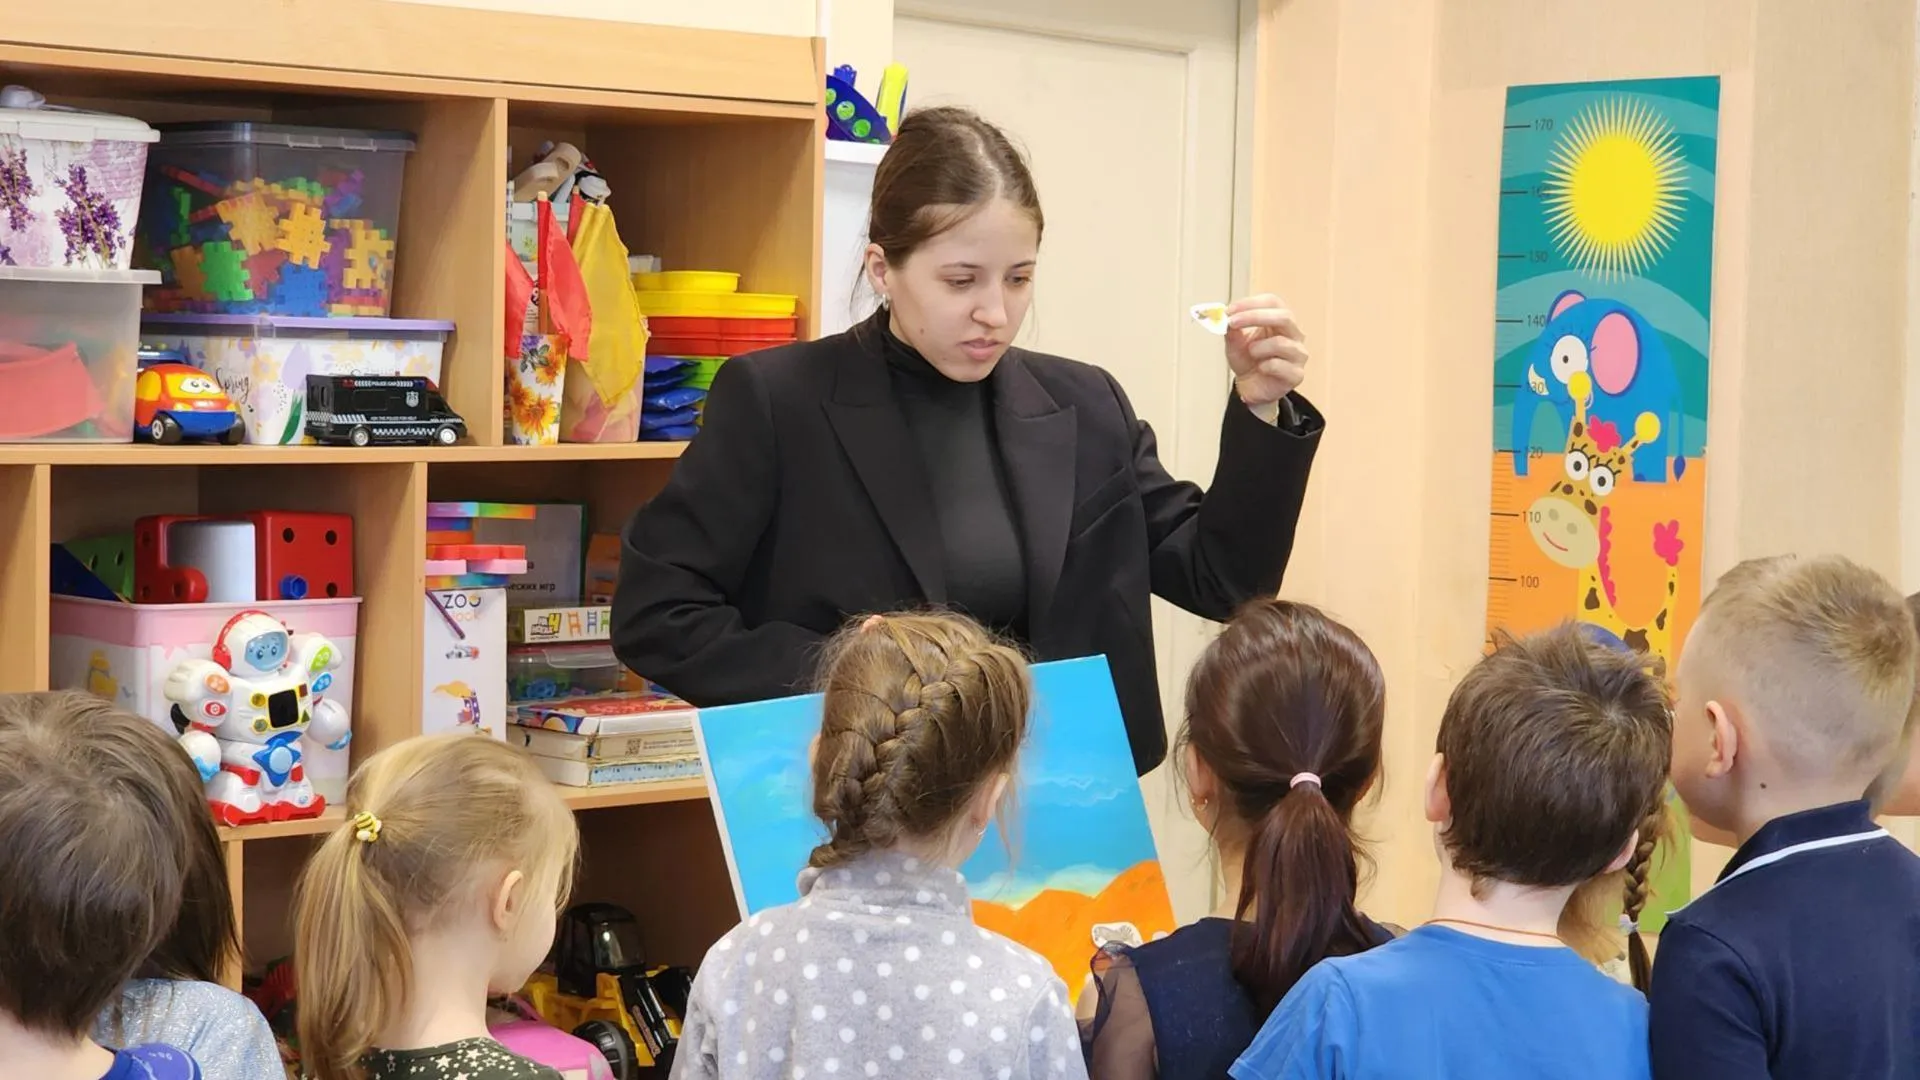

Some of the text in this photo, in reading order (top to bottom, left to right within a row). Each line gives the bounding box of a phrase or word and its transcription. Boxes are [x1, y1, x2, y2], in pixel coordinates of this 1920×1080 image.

[1535, 119, 1554, 131] 170
[1530, 251, 1549, 263] 150
[1528, 314, 1546, 328] 140
[215, 367, 250, 404] Spring
[1527, 381, 1545, 393] 130
[1522, 511, 1542, 524] 110
[539, 583, 556, 593] игр
[1520, 575, 1540, 588] 100
[443, 593, 482, 609] ZOO
